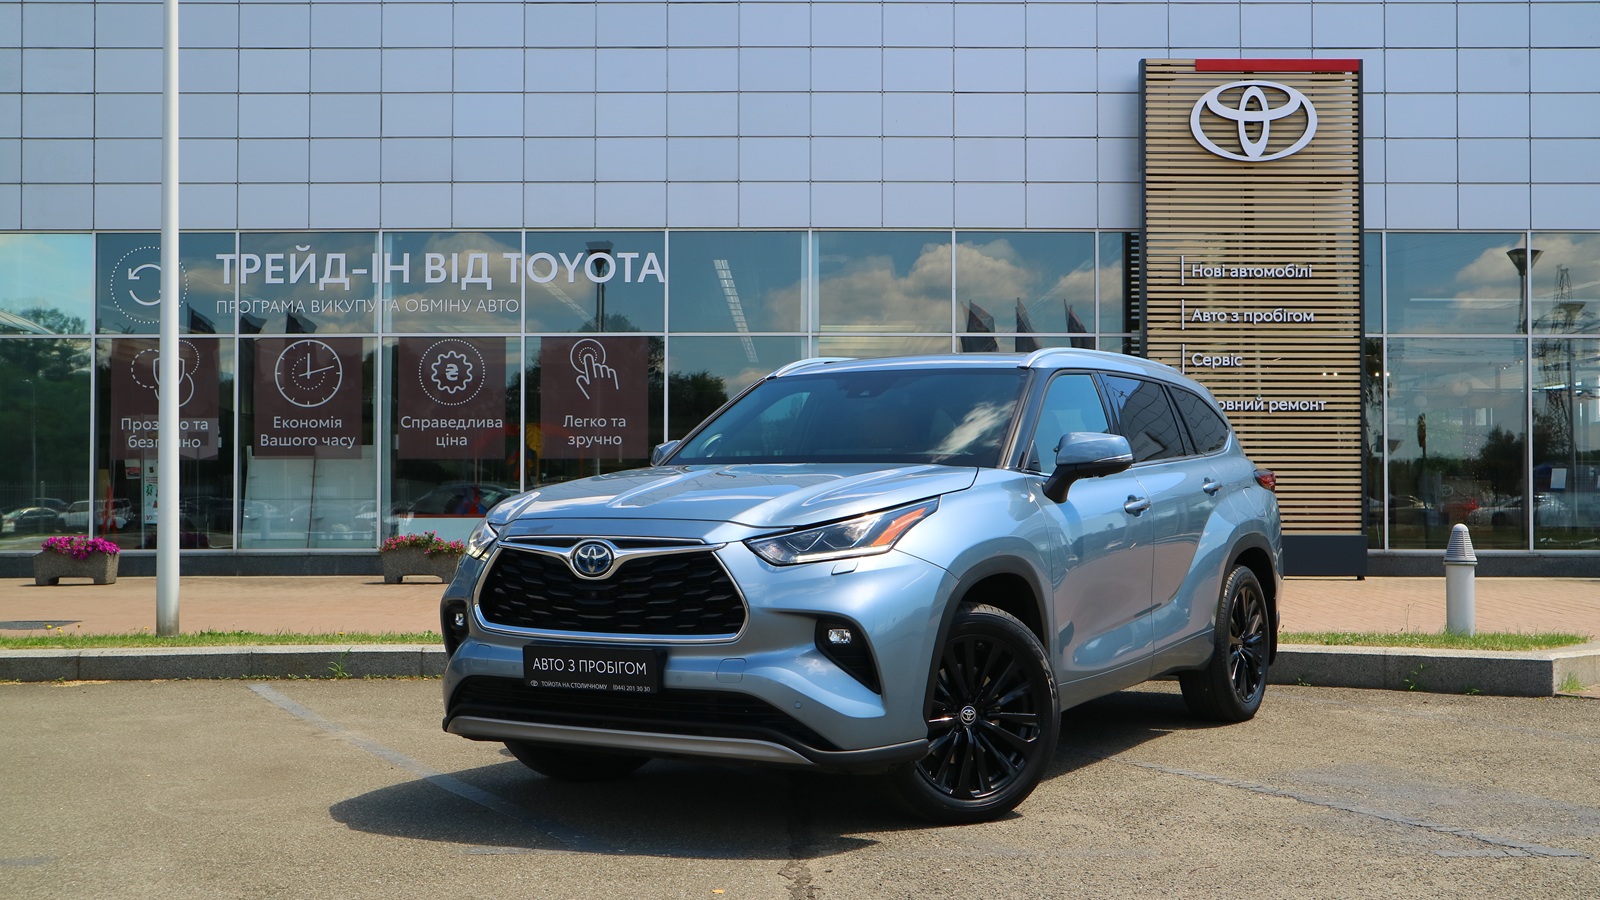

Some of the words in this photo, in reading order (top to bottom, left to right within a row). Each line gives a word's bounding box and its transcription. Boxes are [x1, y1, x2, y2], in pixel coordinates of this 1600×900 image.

[216, 244, 409, 291] ТРЕЙД-ІН
[425, 252, 492, 290] ВІД
[503, 252, 665, 283] TOYOTA
[1191, 264, 1226, 278] Нові
[1230, 264, 1313, 278] автомобілі
[216, 300, 306, 314] ПРОГРАМА
[311, 299, 379, 313] ВИКУПУ
[382, 298, 400, 312] ТА
[405, 298, 472, 313] ОБМІНУ
[476, 298, 519, 312] АВТО
[1191, 308, 1227, 322] Авто
[1230, 312, 1239, 322] з
[1243, 308, 1315, 325] пробігом
[1191, 353, 1243, 369] Сервіс
[1217, 397, 1264, 411] овний
[1268, 400, 1327, 414] ремонт
[121, 417, 189, 433] Прозо
[193, 420, 209, 430] та
[273, 416, 342, 428] Економія
[400, 416, 503, 431] Справедлива
[563, 415, 607, 428] Легко
[611, 417, 626, 428] та
[128, 435, 201, 448] безно
[260, 434, 318, 446] Вашого
[322, 436, 356, 449] часу
[436, 434, 468, 447] ціна
[567, 436, 622, 448] зручно
[532, 657, 565, 671] АВТО
[579, 659, 647, 675] ПРОБІГОМ
[541, 680, 562, 688] ТОЙОТА
[570, 682, 608, 690] СТОЛИЧНОМУ
